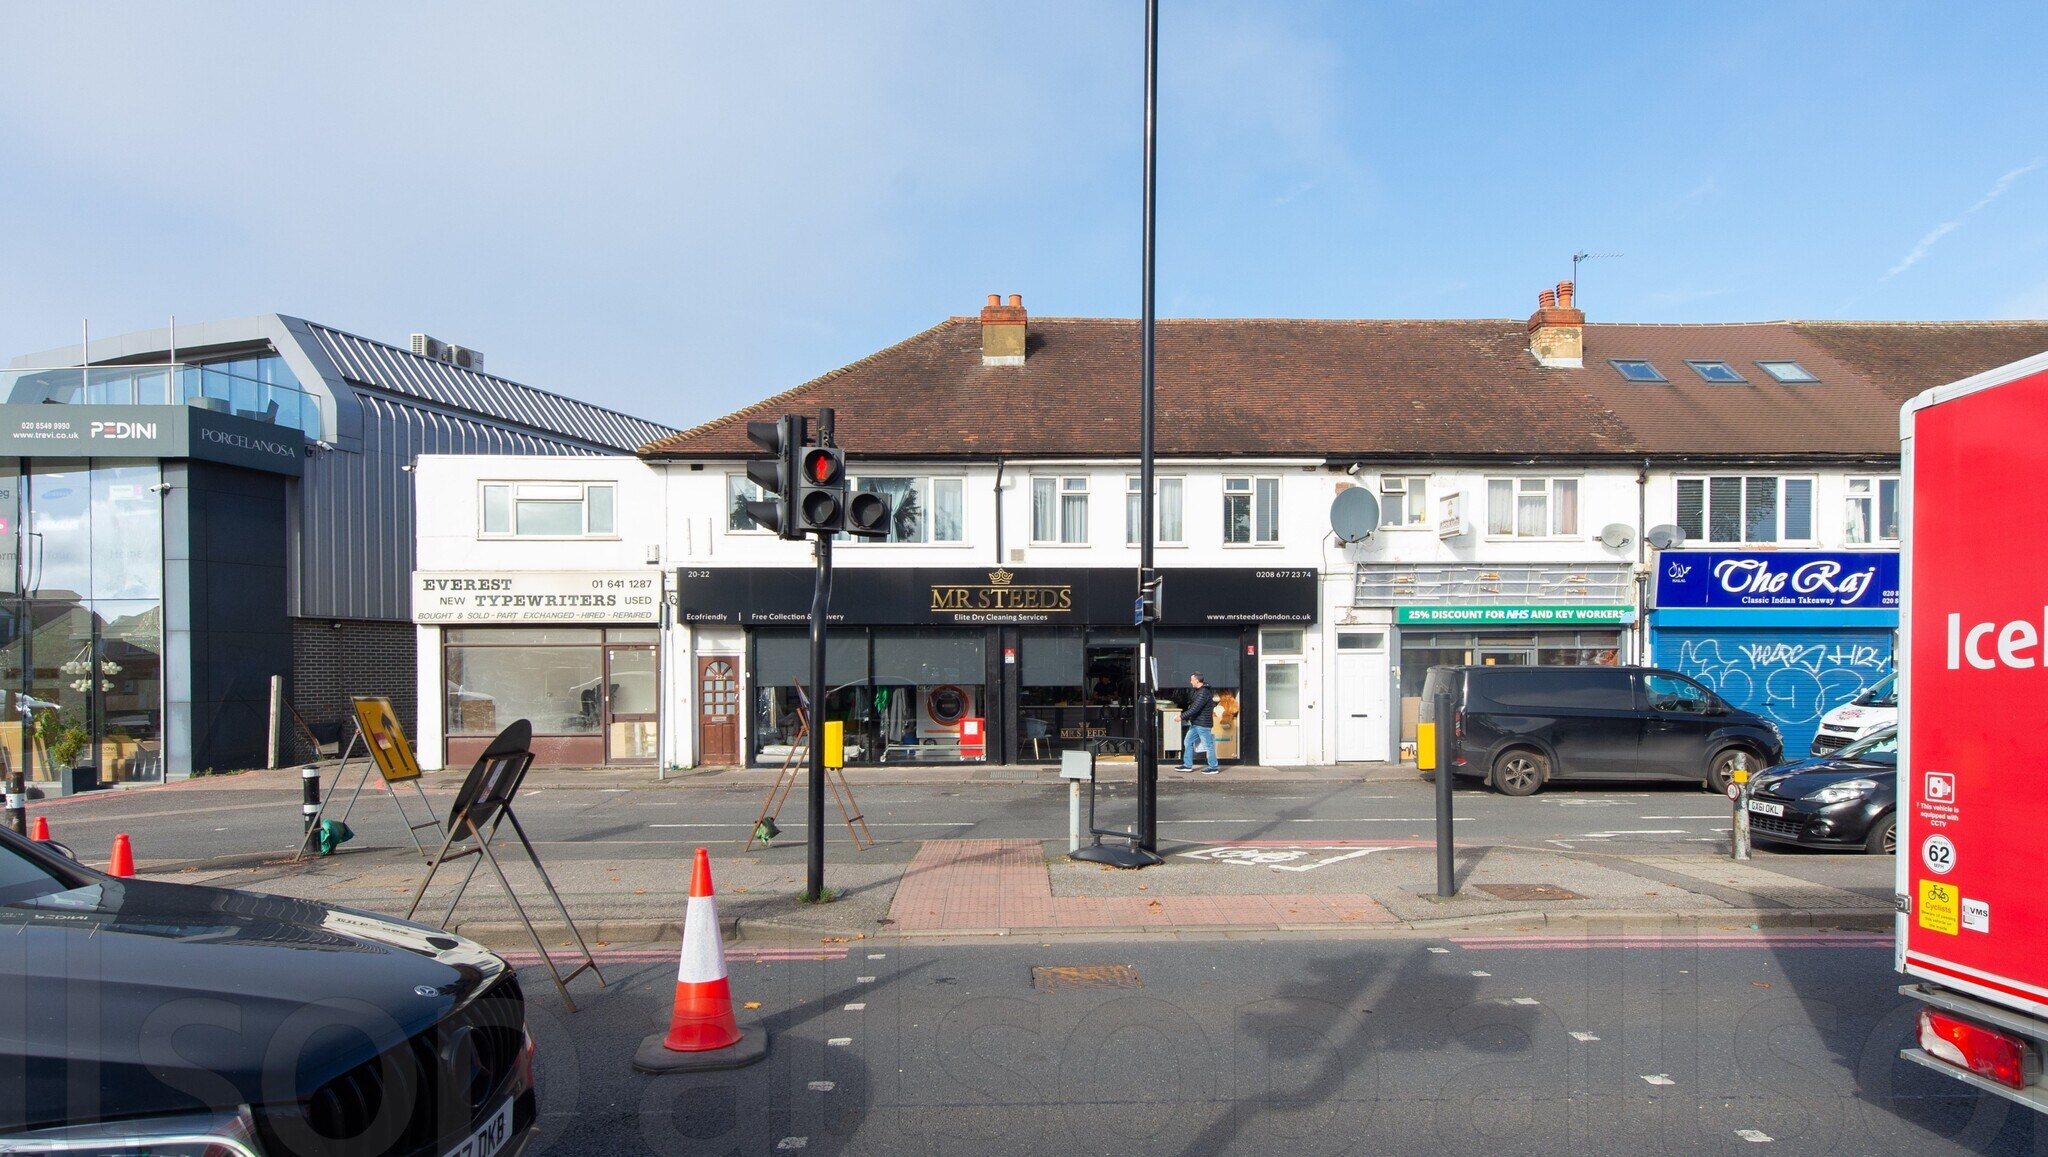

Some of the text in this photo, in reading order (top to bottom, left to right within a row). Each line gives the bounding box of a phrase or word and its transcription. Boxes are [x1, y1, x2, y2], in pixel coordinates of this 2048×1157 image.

[21, 422, 71, 430] 020 8549 9990
[90, 421, 157, 439] PEDINI
[13, 431, 79, 439] www.trevi.co.uk
[201, 428, 296, 458] PORCELANOSA
[687, 570, 710, 578] 20-22
[422, 578, 652, 591] EVEREST 01 641 1287
[1713, 559, 1876, 605] The Raj
[439, 595, 652, 606] NEW TYPEWRITERS USED
[931, 588, 1072, 609] MR STEEDS
[1741, 596, 1835, 606] Classic Indian Takeaway
[418, 612, 453, 620] BOUGHT
[523, 611, 575, 619] EXCHANGED
[581, 611, 606, 619] HIRED
[612, 611, 652, 619] REPAIRED
[686, 613, 728, 622] Ecofriendly
[954, 613, 1048, 622] Elite Dry Cleaning Services
[1206, 613, 1311, 621] www.mrsteedsoflondon.co.uk
[1408, 609, 1625, 619] 25% DISCOUNT FOR NHS AND KEY WORKERS
[1920, 802, 1932, 811] This
[1933, 804, 1953, 813] vehicle
[1920, 811, 1946, 820] equipped
[1930, 819, 1947, 828] CCTV
[1928, 844, 1950, 864] 62
[1925, 901, 1952, 914] Cyclists
[1969, 907, 1988, 918] VMS
